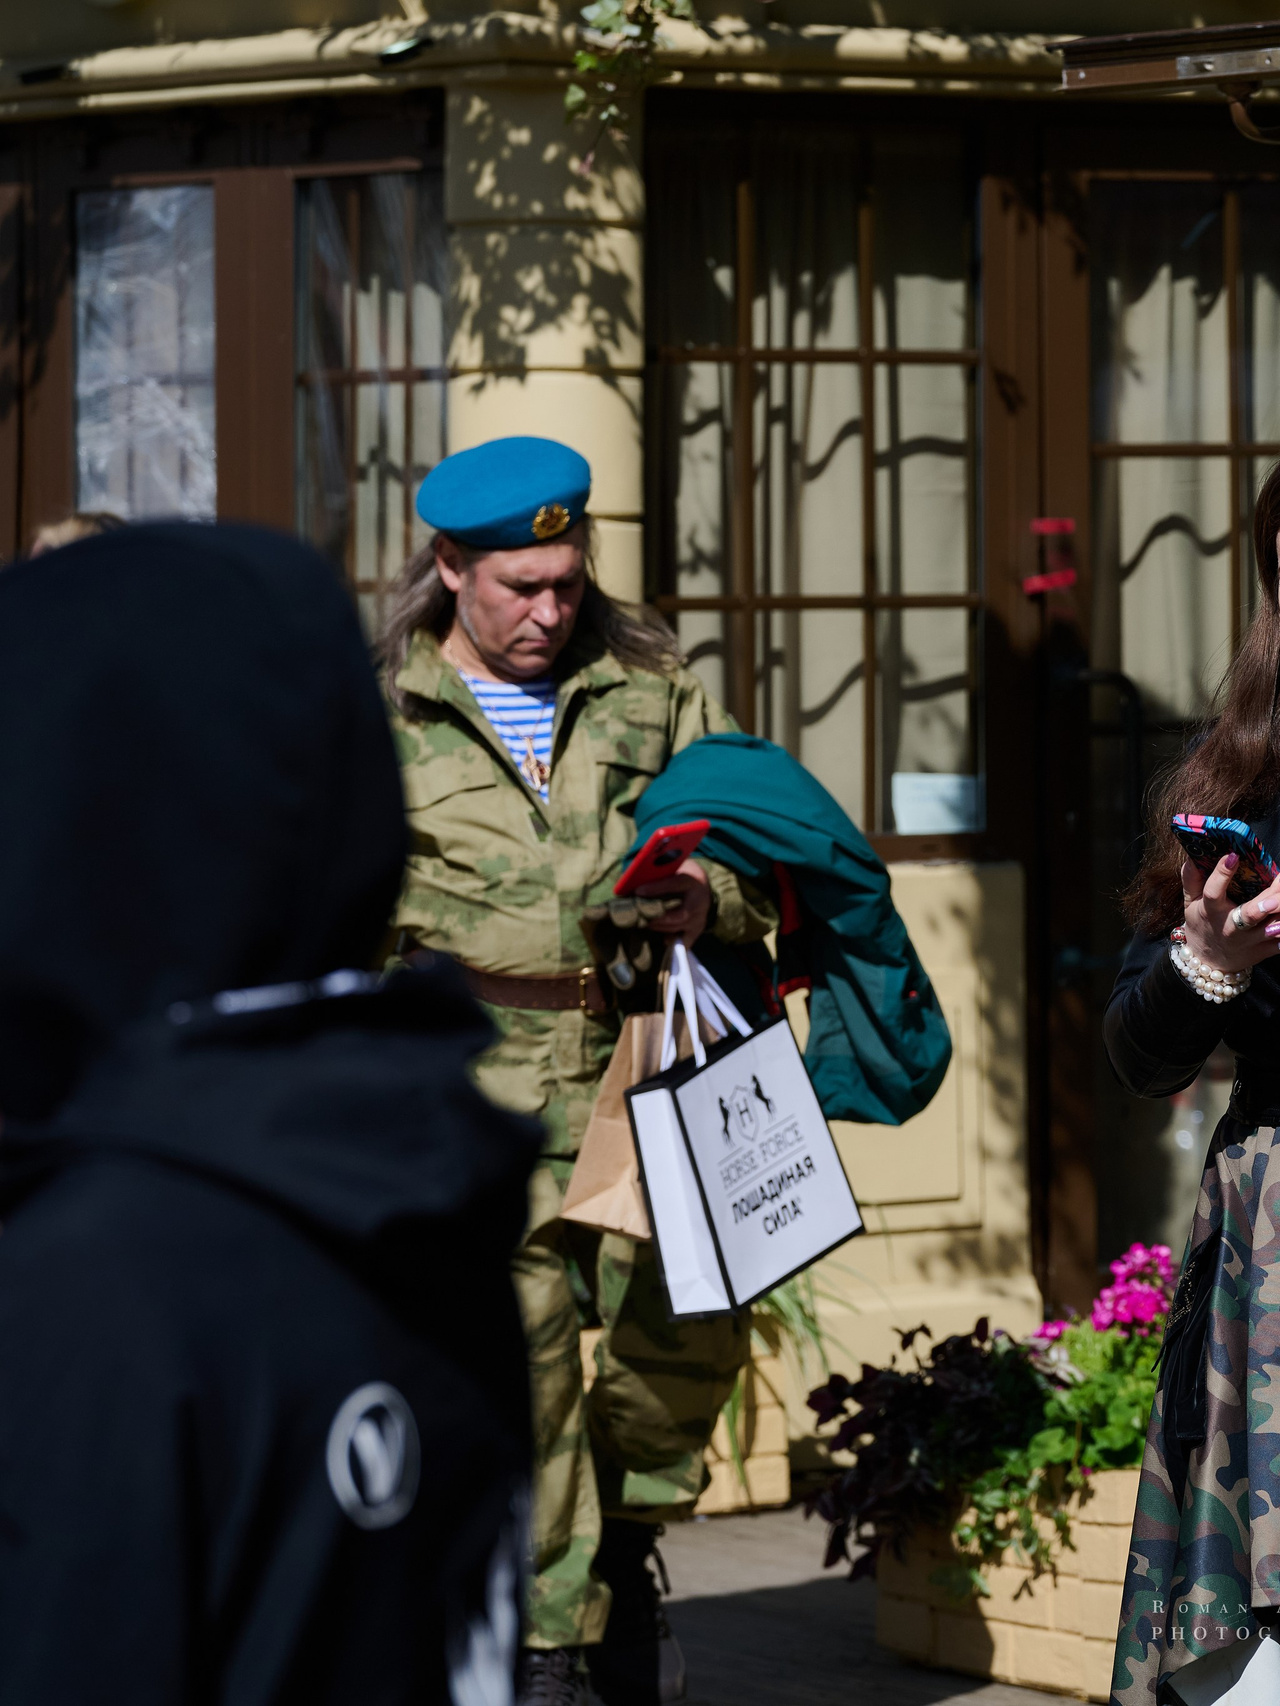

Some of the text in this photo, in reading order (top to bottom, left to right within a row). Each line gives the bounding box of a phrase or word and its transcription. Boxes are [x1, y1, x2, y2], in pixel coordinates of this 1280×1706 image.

[720, 1121, 803, 1189] HORSE FORCE
[732, 1155, 816, 1224] ЛОШАДИНАЯ
[762, 1198, 803, 1235] СИЛА
